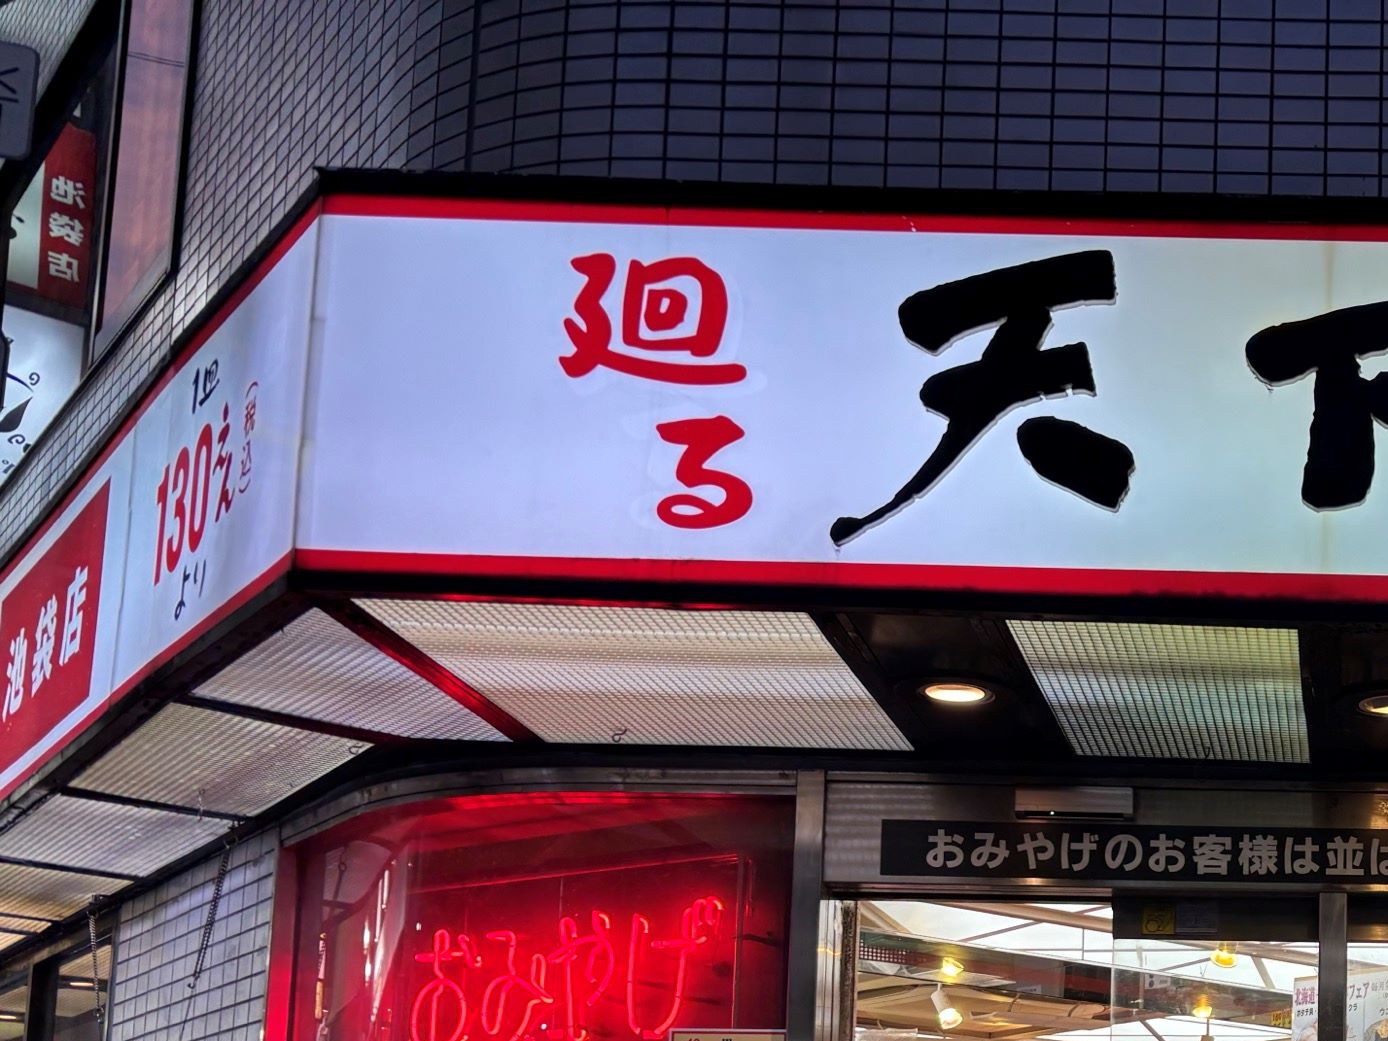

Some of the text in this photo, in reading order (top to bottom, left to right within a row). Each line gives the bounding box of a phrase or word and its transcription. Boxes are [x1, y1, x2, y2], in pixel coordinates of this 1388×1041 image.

[190, 358, 220, 415] 1皿
[560, 252, 753, 530] 廻る
[2, 564, 89, 723] 池袋店
[173, 558, 207, 622] より
